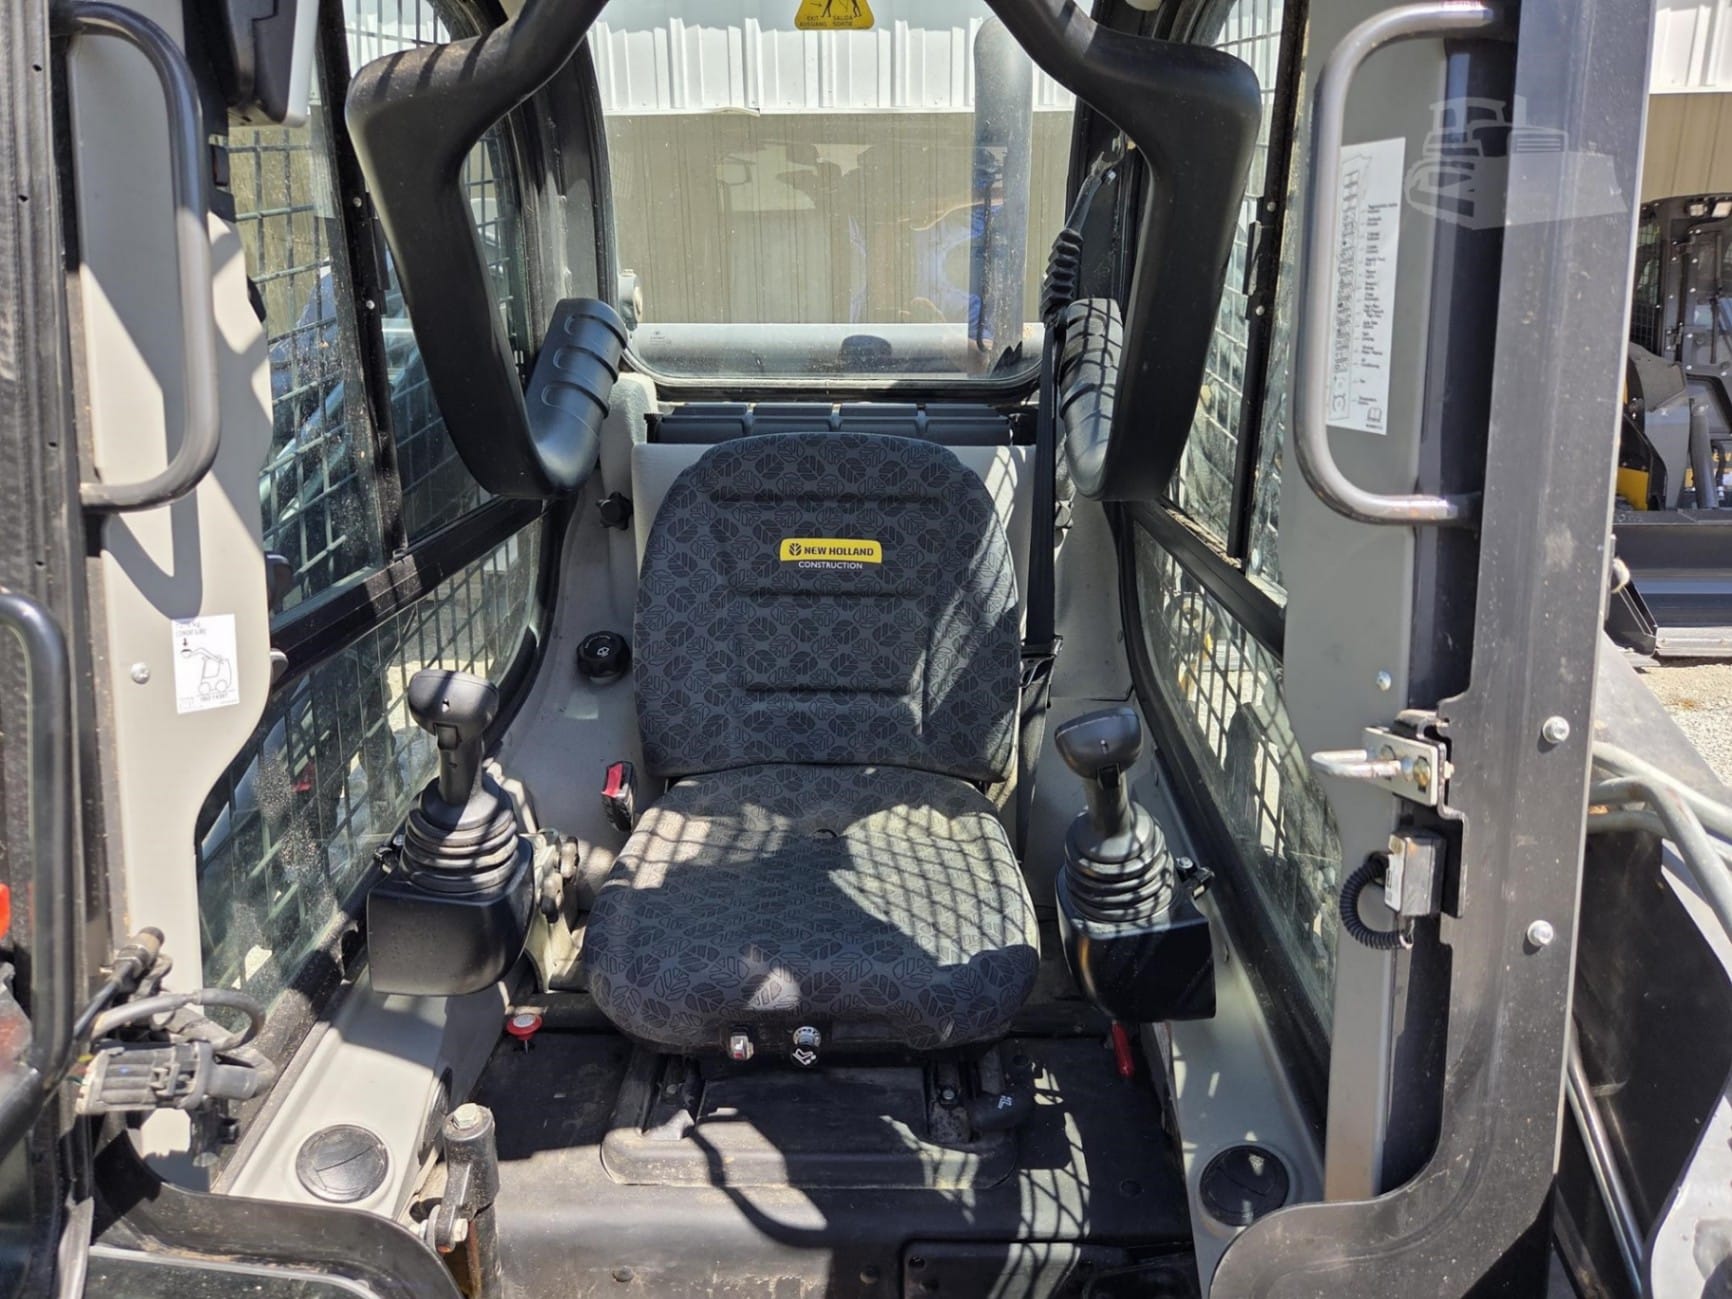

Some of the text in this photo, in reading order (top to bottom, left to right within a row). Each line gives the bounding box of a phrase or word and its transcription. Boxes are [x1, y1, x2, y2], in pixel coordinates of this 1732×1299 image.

[804, 546, 874, 556] NEW HOLLAND
[798, 561, 863, 569] CONSTRUCTION
